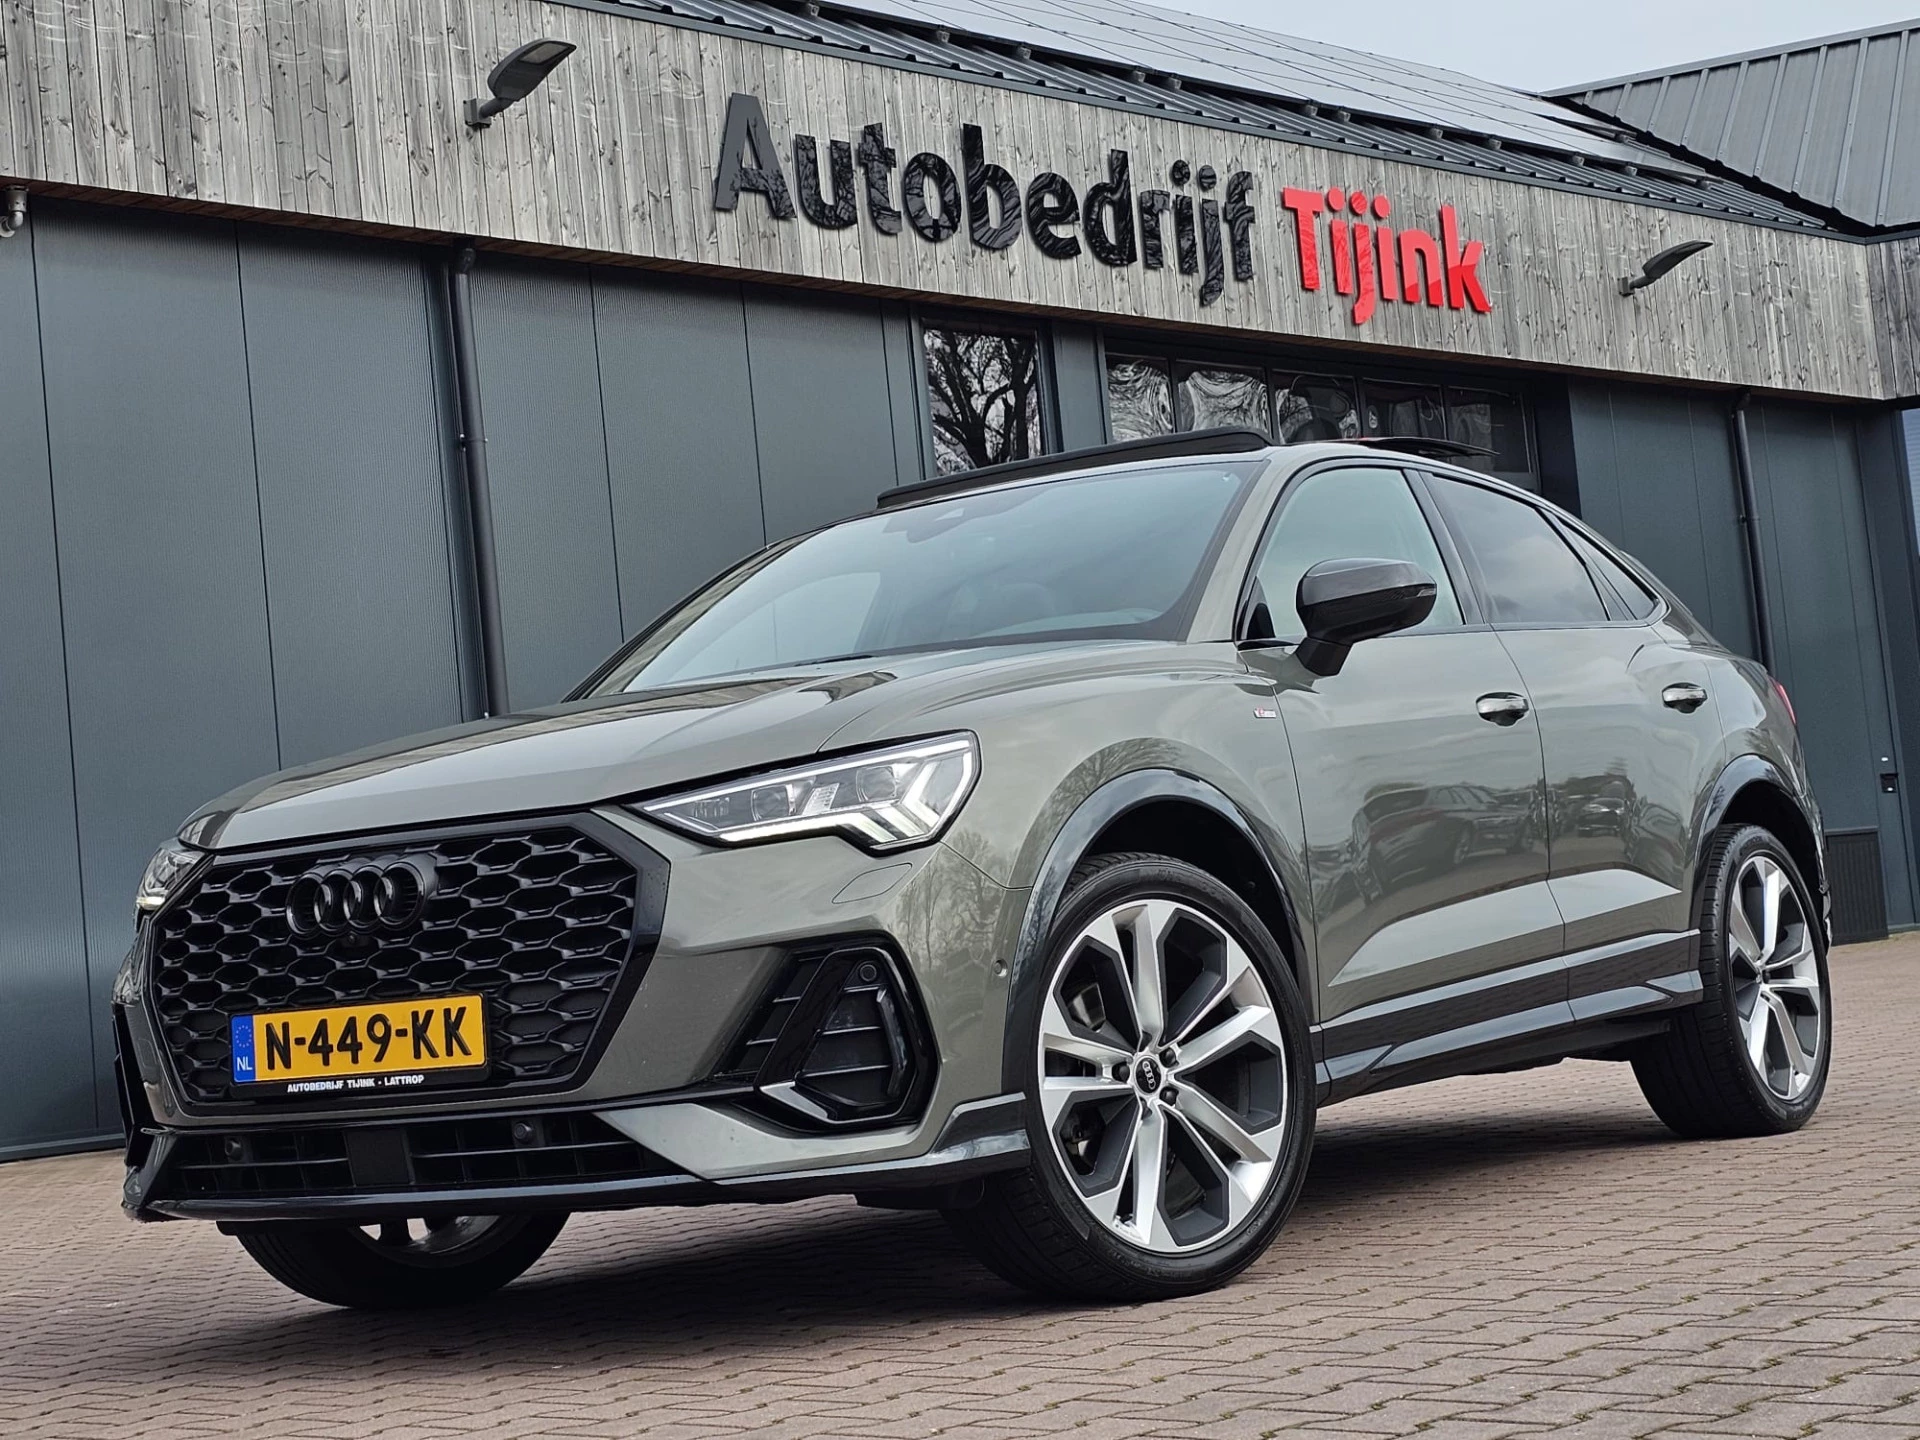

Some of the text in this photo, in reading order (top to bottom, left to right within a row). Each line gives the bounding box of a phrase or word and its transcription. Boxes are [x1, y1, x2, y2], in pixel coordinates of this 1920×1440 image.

[715, 93, 1492, 325] Autobedrijf Tijink
[265, 1006, 472, 1071] N-449-KK
[236, 1055, 253, 1071] NL
[287, 1080, 344, 1093] AUTOBEDRIJF
[346, 1078, 375, 1088] TIJINK
[384, 1074, 425, 1087] LATTROP
